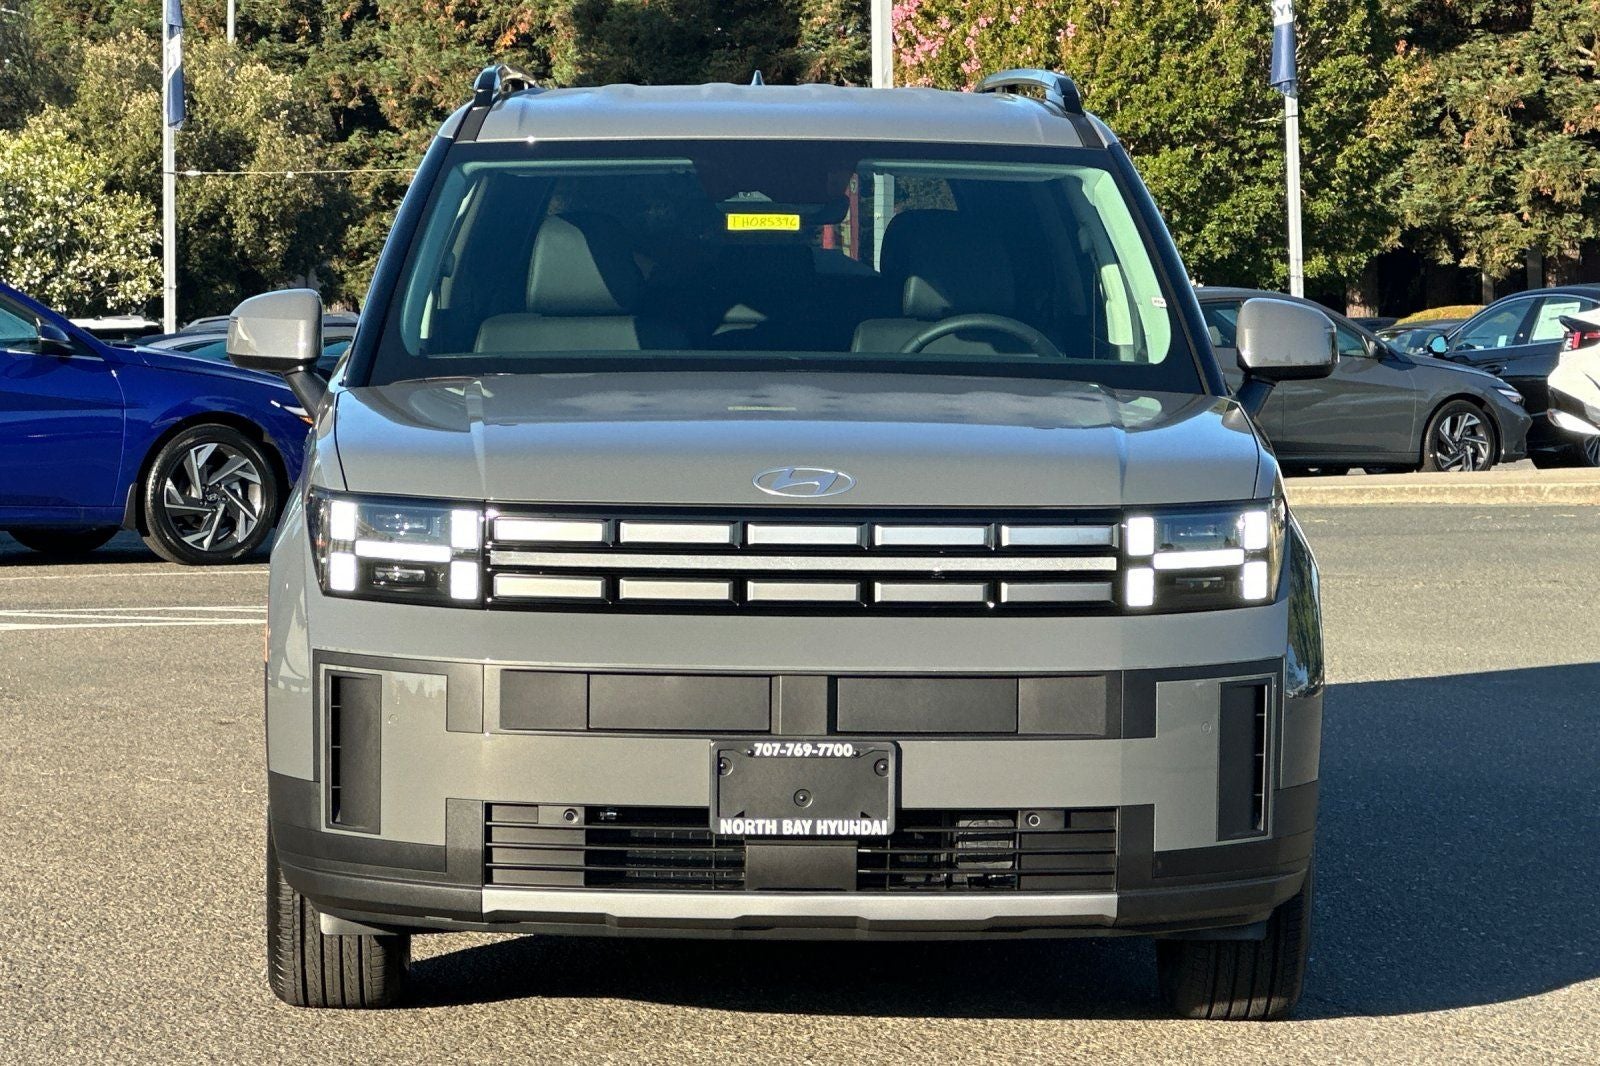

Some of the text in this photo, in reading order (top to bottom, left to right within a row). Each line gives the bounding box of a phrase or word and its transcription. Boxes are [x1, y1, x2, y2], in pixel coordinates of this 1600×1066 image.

[753, 743, 853, 757] 707-769-7700
[720, 819, 888, 836] NORTH BAY HYUNDAI
